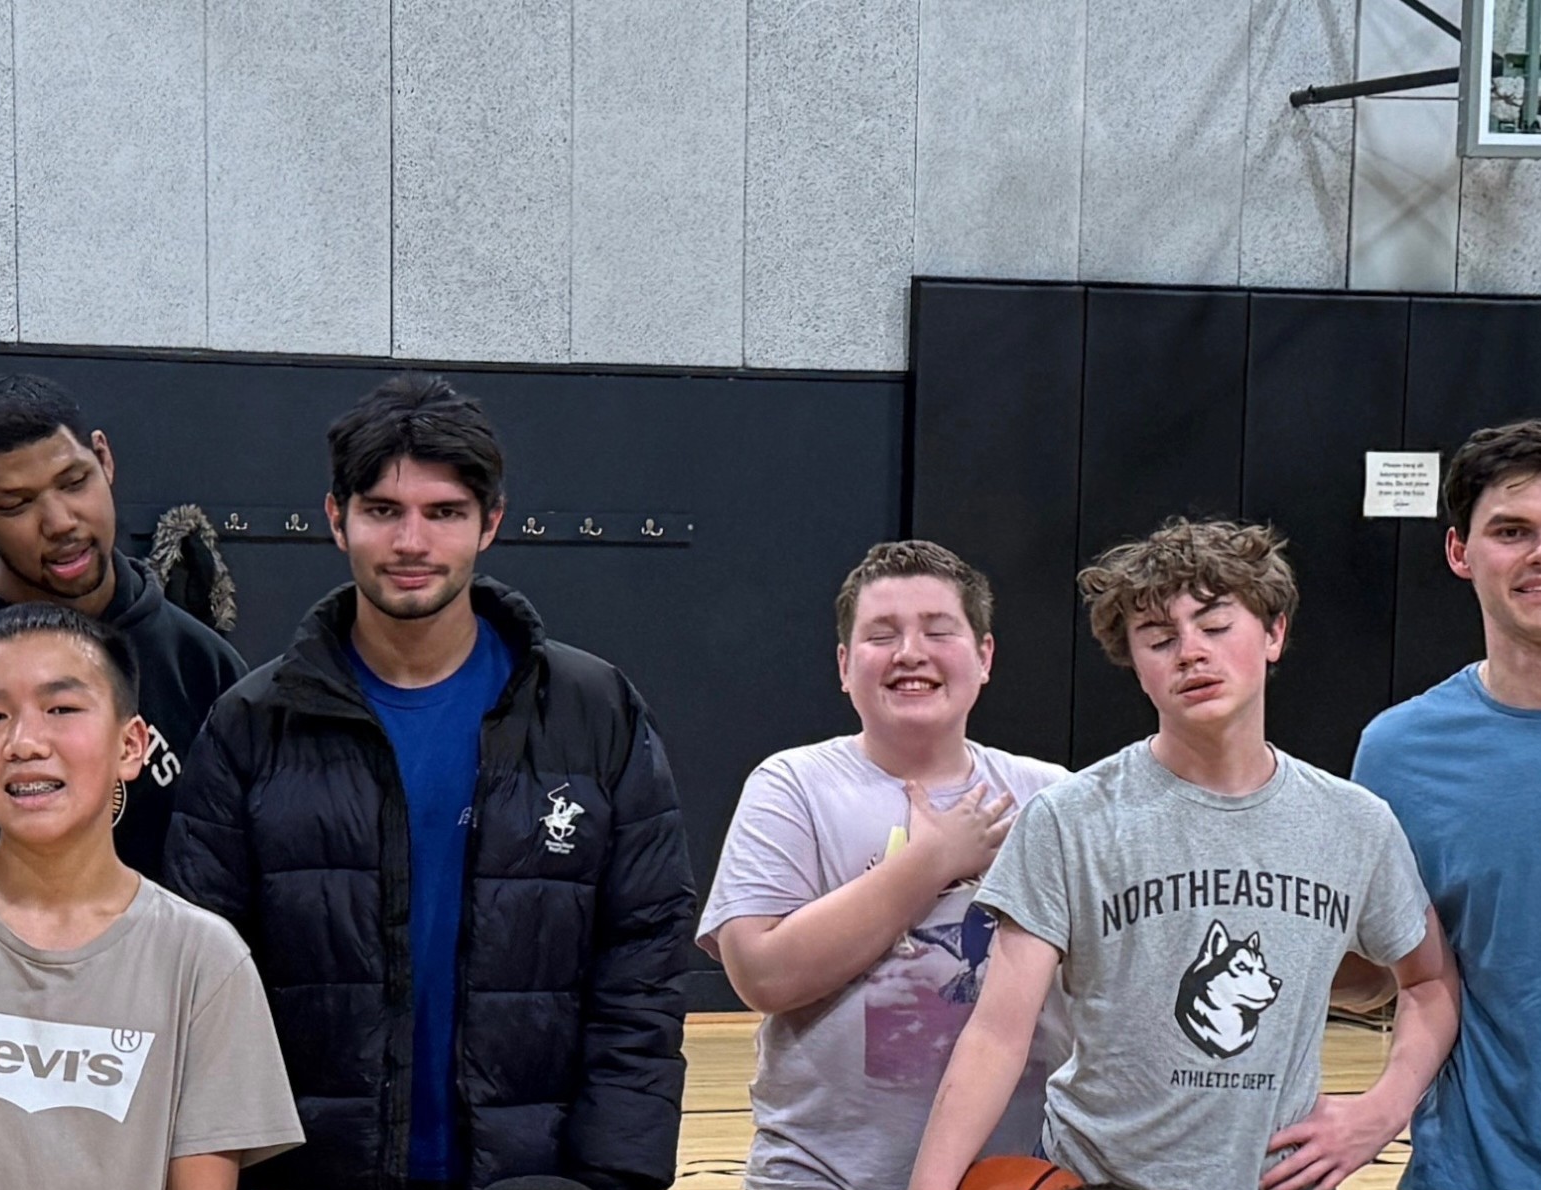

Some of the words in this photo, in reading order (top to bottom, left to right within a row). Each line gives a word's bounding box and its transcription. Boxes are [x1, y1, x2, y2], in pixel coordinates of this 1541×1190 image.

[1102, 869, 1350, 937] NORTHEASTERN
[1170, 1069, 1240, 1089] ATHLETIC
[1242, 1073, 1276, 1091] DEPT.
